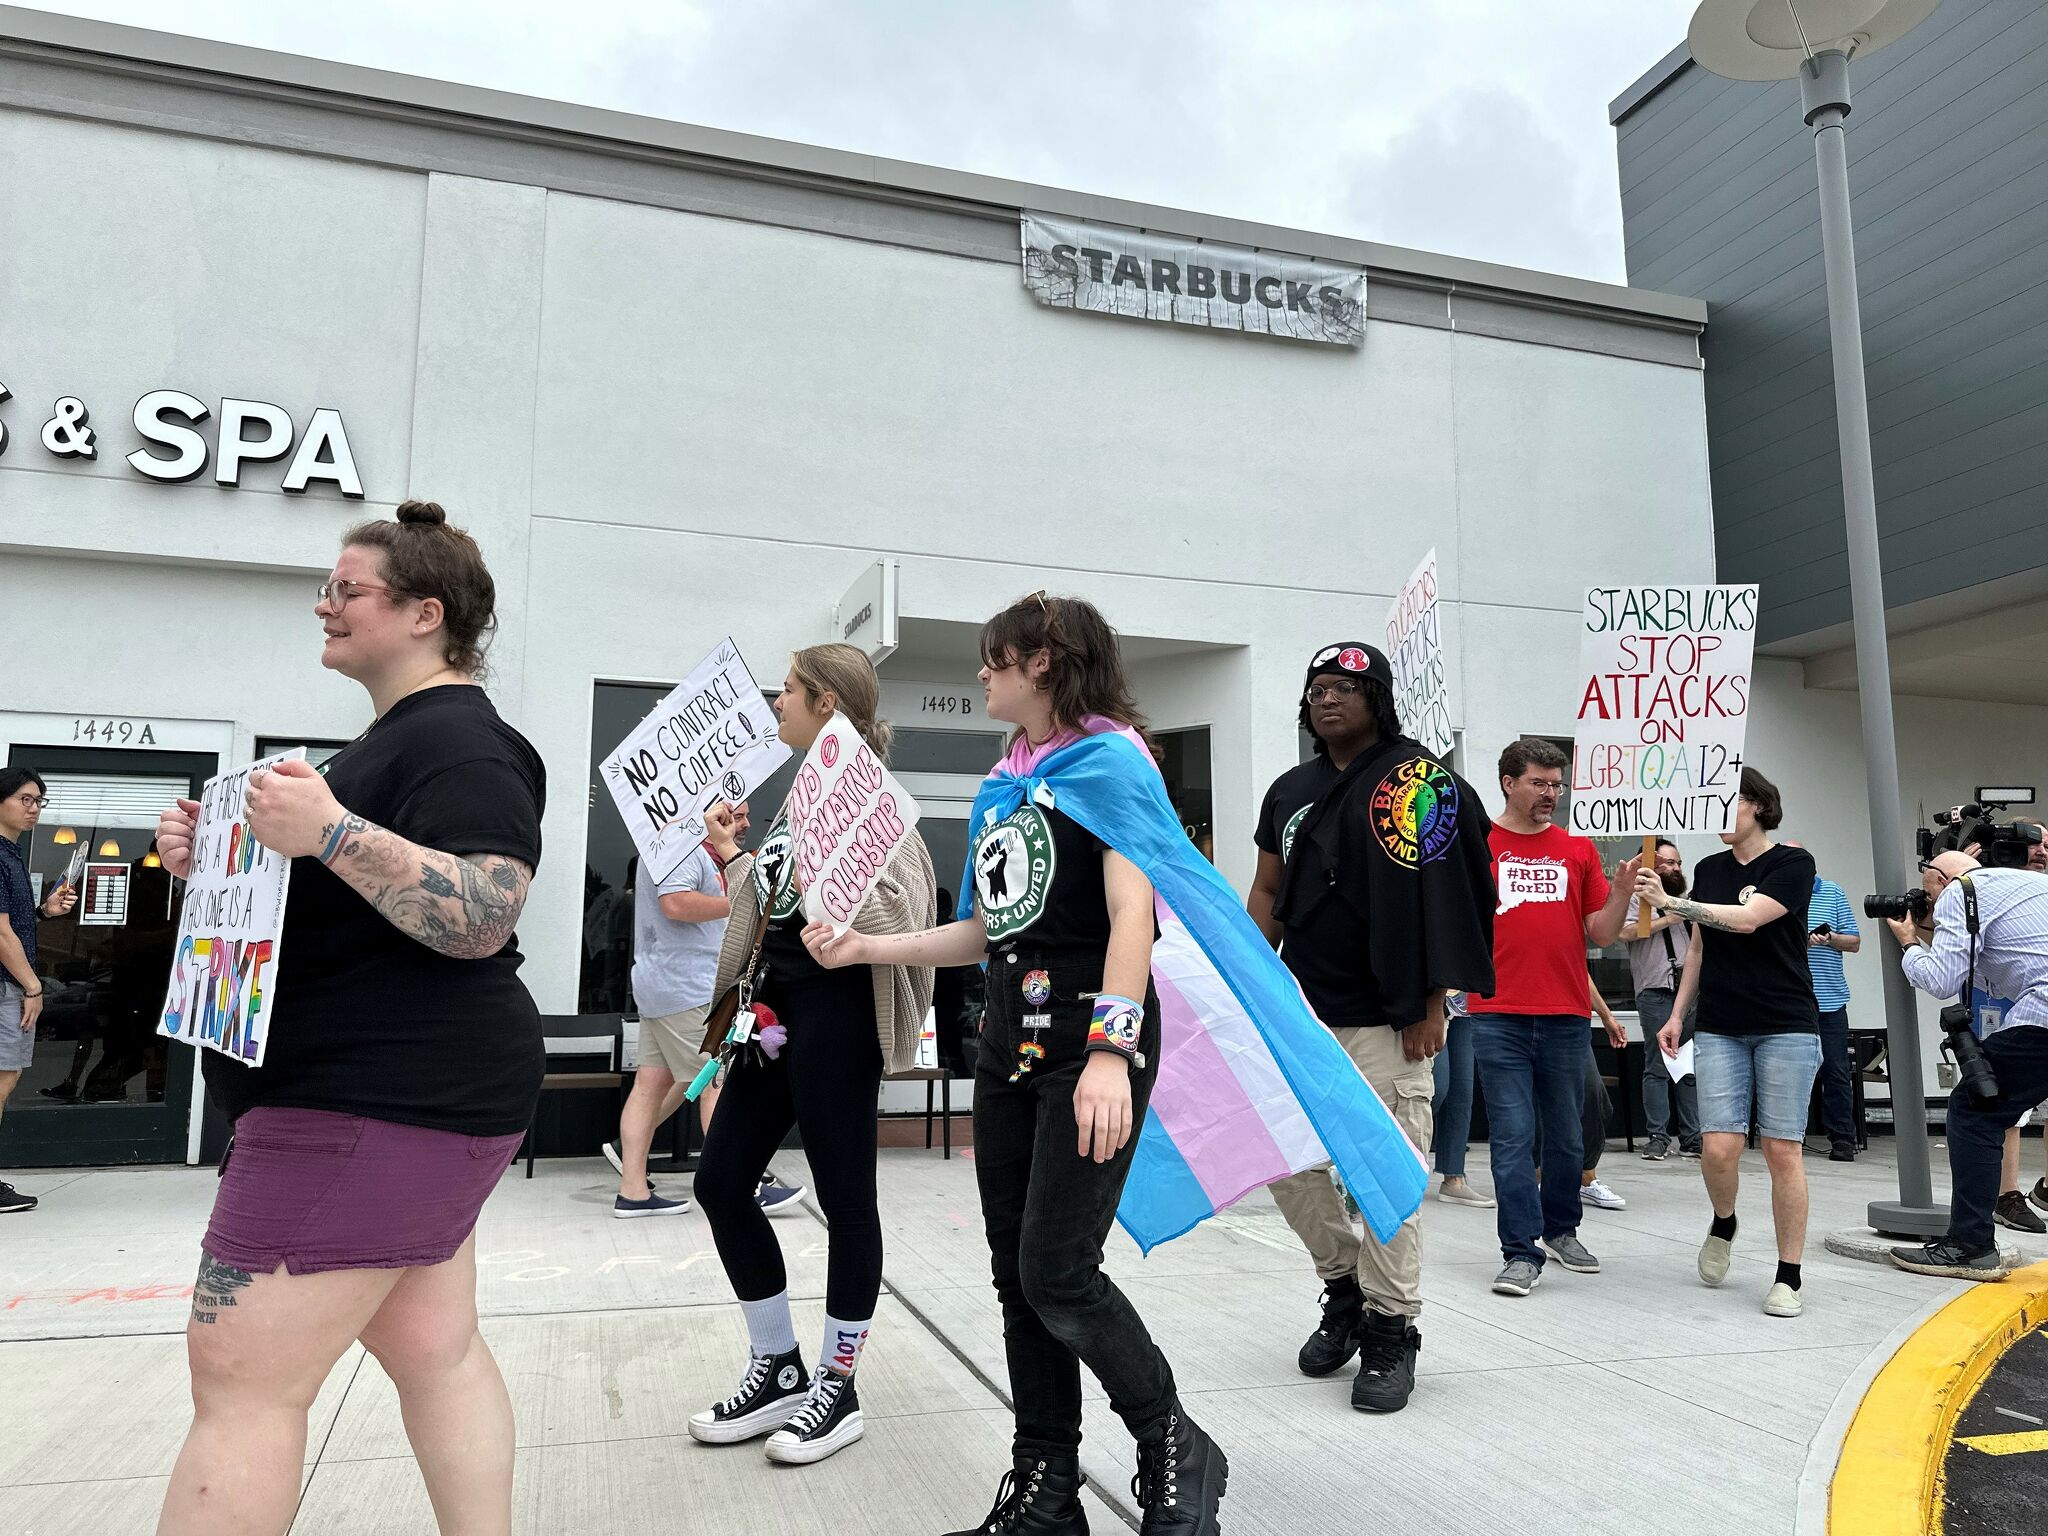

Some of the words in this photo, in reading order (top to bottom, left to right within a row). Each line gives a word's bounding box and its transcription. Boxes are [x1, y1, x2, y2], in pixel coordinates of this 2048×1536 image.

[1051, 244, 1344, 317] STARBUCKS
[41, 396, 97, 460] &
[125, 389, 365, 500] SPA
[844, 602, 872, 640] STARBUCKS
[1386, 562, 1437, 661] EDUCATORS
[1586, 588, 1757, 633] STARBUCKS
[1390, 600, 1439, 701] SUPPORT
[1617, 634, 1722, 676] STOP
[1395, 649, 1444, 734] TARBUCKS
[1577, 674, 1747, 720] ATTACKS
[622, 748, 658, 796] NO
[657, 668, 740, 761] CONTRACT
[1640, 718, 1684, 745] ON
[198, 782, 218, 828] THE
[217, 769, 248, 820] FIRST
[788, 763, 822, 843] END
[1374, 780, 1398, 810] BE
[1397, 760, 1447, 783] GAY
[643, 786, 679, 832] NO
[1573, 792, 1737, 833] COMMUNITY
[213, 834, 222, 869] A
[821, 791, 905, 923] ALLYSHIP
[1384, 833, 1418, 862] AND
[1497, 850, 1566, 866] Connecticut
[1013, 857, 1047, 920] UNITED
[1506, 867, 1559, 881] #RED
[1510, 881, 1557, 894] forED
[182, 887, 203, 932] THIS
[205, 888, 229, 929] ONE
[228, 885, 241, 928] IS
[242, 887, 253, 929] A
[165, 935, 273, 1060] STRIKE
[1022, 1014, 1051, 1027] PRIDE
[219, 1295, 237, 1307] SEA
[831, 1330, 859, 1374] LOV
